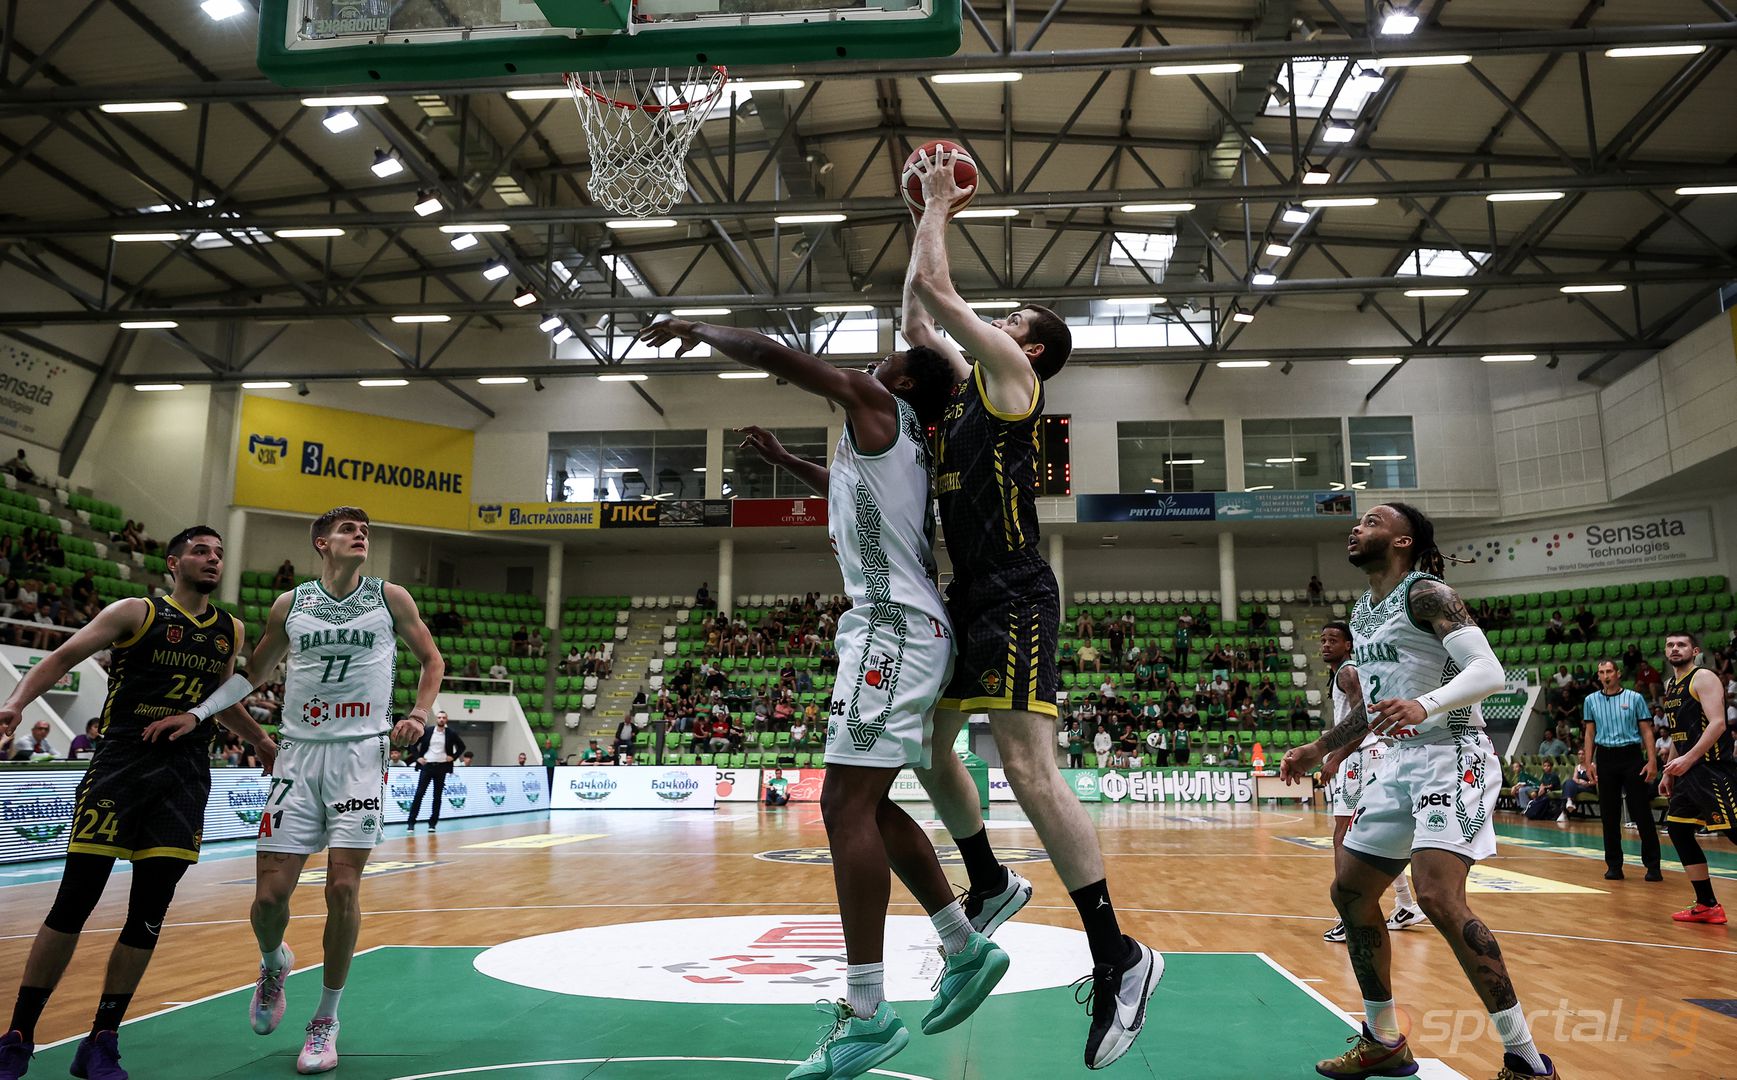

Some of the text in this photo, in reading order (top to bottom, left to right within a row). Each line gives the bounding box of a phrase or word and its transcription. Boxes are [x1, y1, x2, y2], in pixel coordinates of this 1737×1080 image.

[301, 441, 463, 494] ЗАСТРАХОВАНЕ
[510, 508, 593, 525] ЗАСТРАХОВАНЕ
[611, 504, 657, 522] ЛКС
[1129, 507, 1211, 518] PHYTO PHARMA
[1586, 518, 1686, 546] Sensata
[1588, 541, 1670, 559] Technologies
[300, 629, 376, 652] BALKAN
[151, 649, 207, 671] MINYOR
[321, 655, 351, 683] 77
[163, 674, 204, 703] 24
[570, 778, 618, 791] Бачково
[651, 778, 699, 791] Бачково
[1101, 770, 1166, 803] ФЕН
[1172, 770, 1253, 803] КЛУБ
[333, 796, 380, 814] efbet
[76, 808, 119, 842] 24
